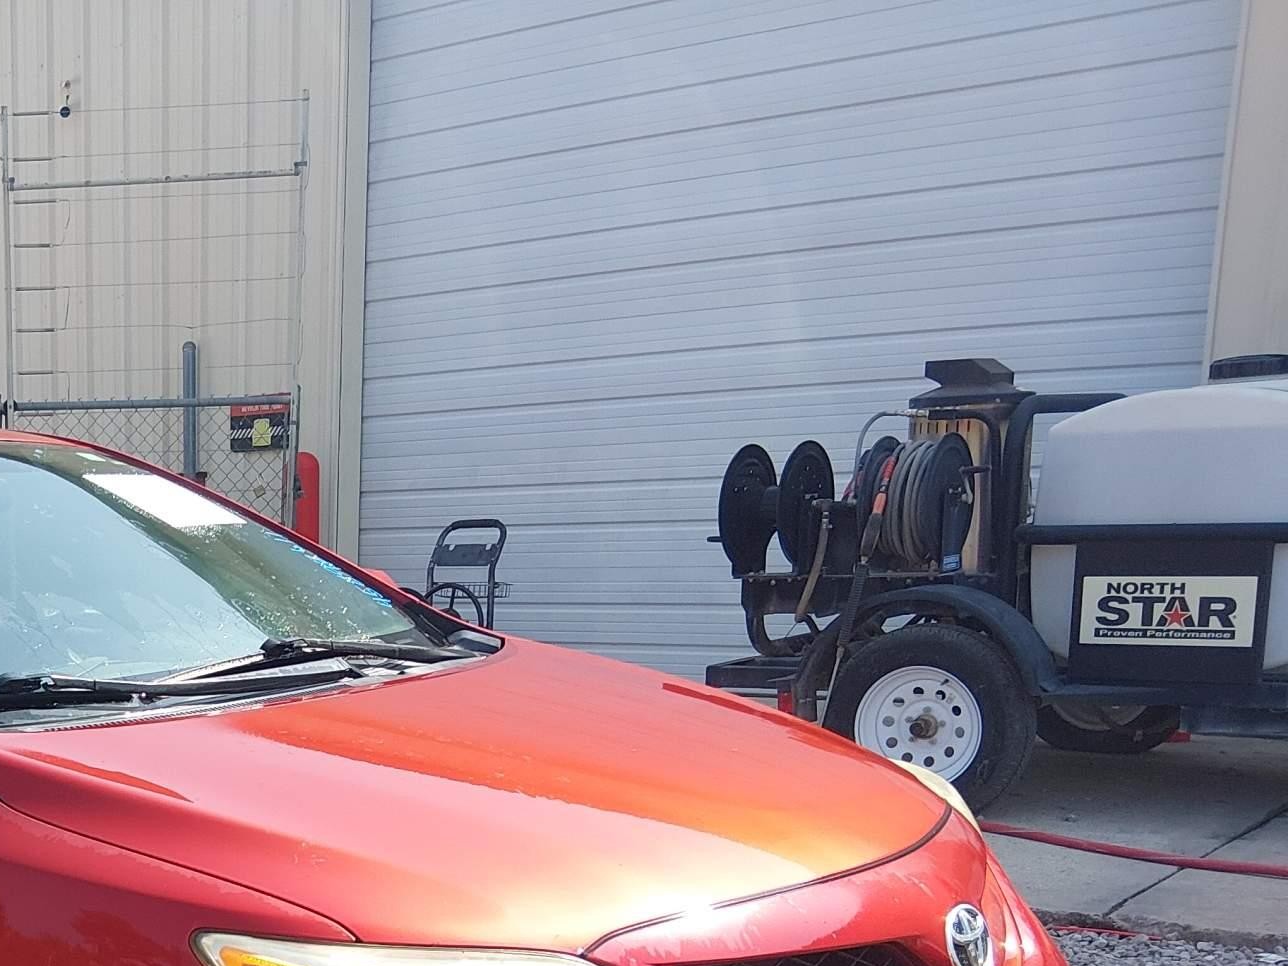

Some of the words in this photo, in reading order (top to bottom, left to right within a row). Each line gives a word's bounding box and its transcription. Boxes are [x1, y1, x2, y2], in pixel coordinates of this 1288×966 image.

[1106, 582, 1186, 595] NORTH
[1095, 595, 1237, 628] STAR
[1099, 629, 1143, 637] Proven
[1146, 628, 1232, 639] Performance
